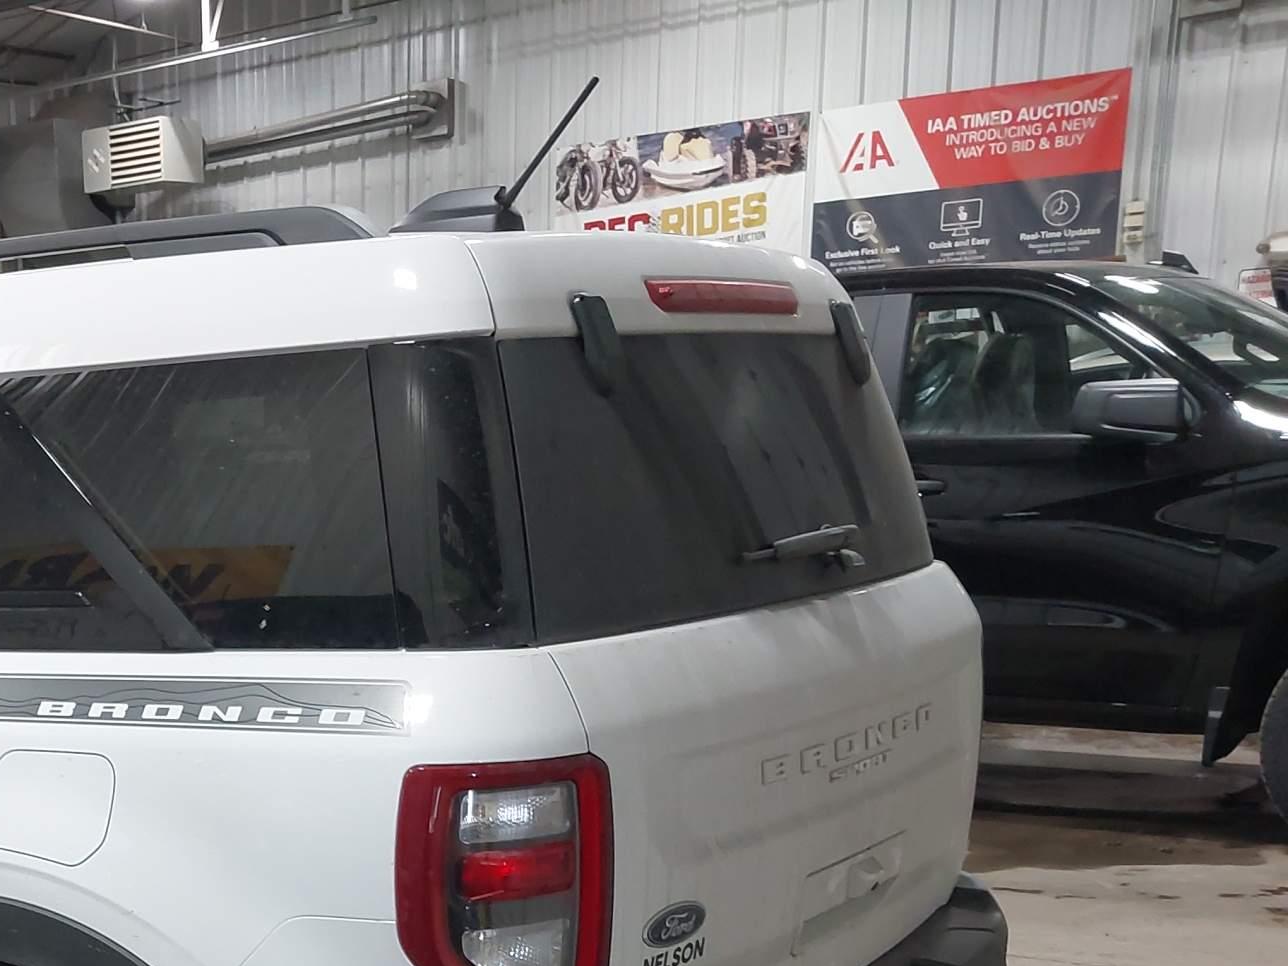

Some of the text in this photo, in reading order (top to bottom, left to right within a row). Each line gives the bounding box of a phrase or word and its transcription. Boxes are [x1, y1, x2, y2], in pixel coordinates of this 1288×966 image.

[927, 116, 957, 134] IAA
[961, 109, 1013, 130] TIMED
[945, 117, 1098, 146] INTRODUCING A NEW
[954, 133, 1087, 160] WAY TO BID & BUY
[660, 191, 768, 237] RIDES
[928, 237, 991, 250] Quick and Easy
[1019, 228, 1101, 241] Real-Time Updates
[824, 249, 860, 260] Exclusive
[36, 700, 366, 726] BRONCO
[761, 702, 932, 786] BRONCO
